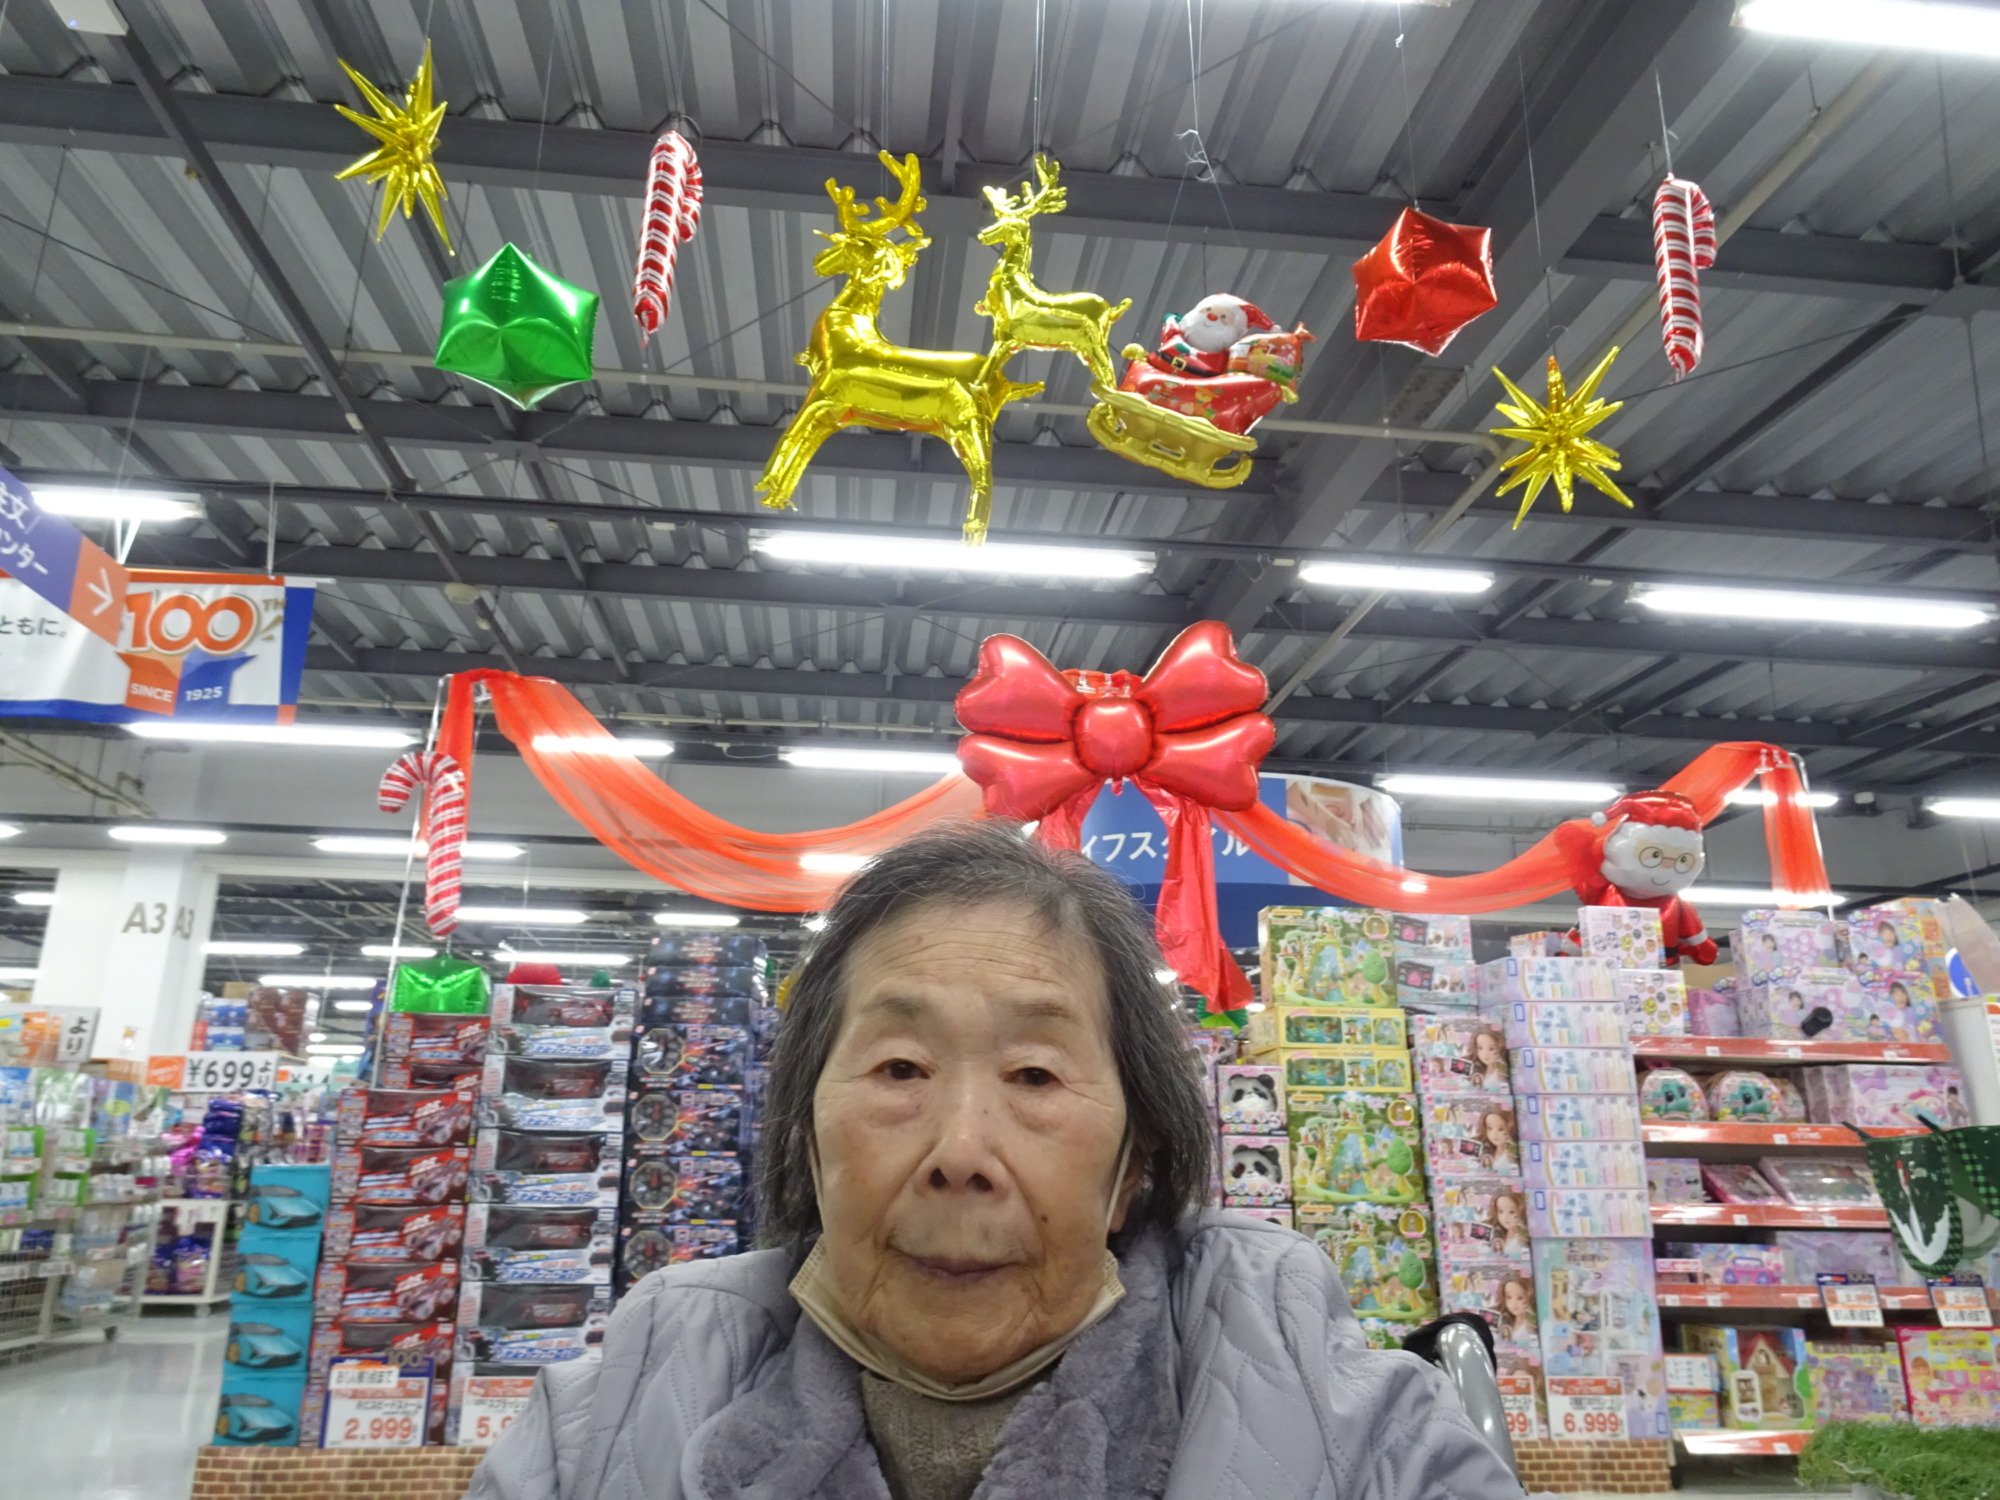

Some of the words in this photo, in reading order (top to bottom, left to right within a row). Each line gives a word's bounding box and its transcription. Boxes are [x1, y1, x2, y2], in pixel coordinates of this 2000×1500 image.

[125, 590, 258, 655] 100
[262, 598, 288, 612] TH
[131, 683, 174, 702] SINCE
[186, 686, 224, 701] 1925
[1082, 828, 1249, 862] イフスル
[121, 901, 168, 934] A3
[172, 905, 195, 940] A3
